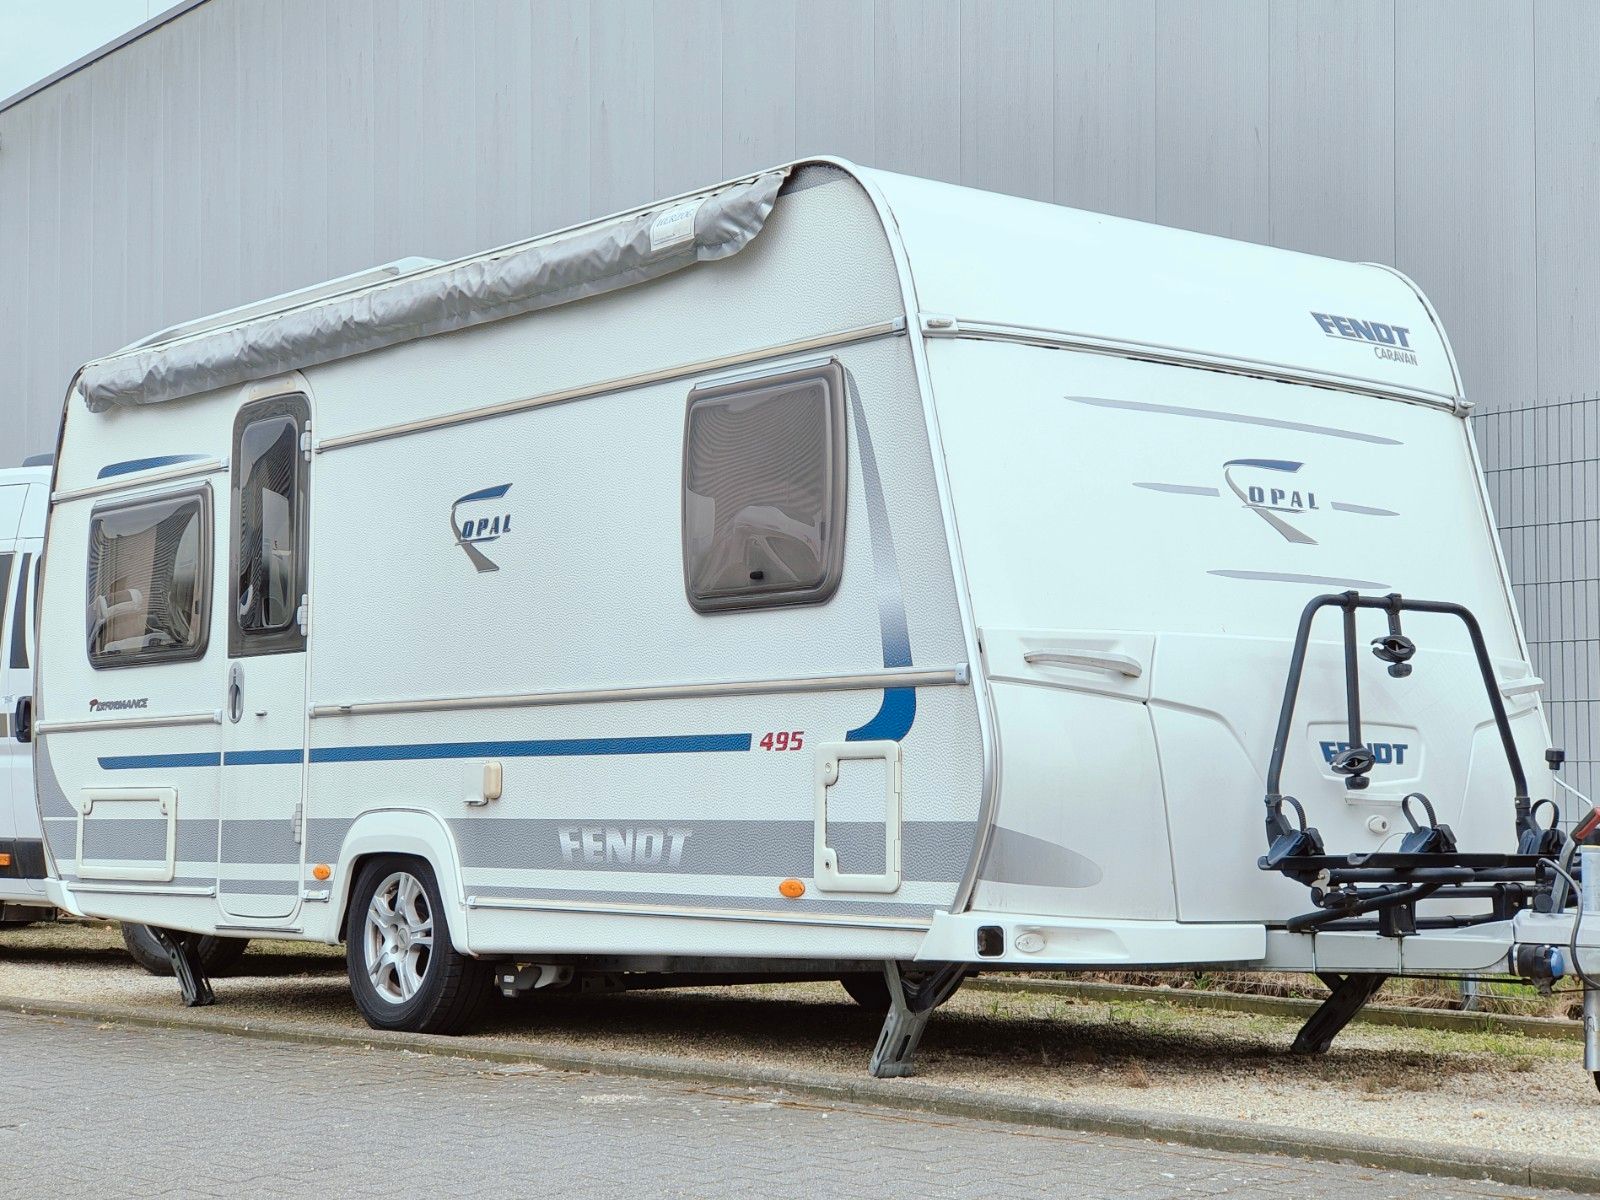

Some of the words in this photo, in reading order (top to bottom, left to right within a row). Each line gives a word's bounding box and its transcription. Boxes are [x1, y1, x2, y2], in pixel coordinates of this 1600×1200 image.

[1310, 311, 1410, 348] FENDT
[1374, 346, 1418, 366] CARAVAN
[1248, 485, 1320, 510] OPAL
[461, 513, 512, 539] OPAL
[760, 731, 804, 751] 495
[558, 826, 694, 867] FENDT
